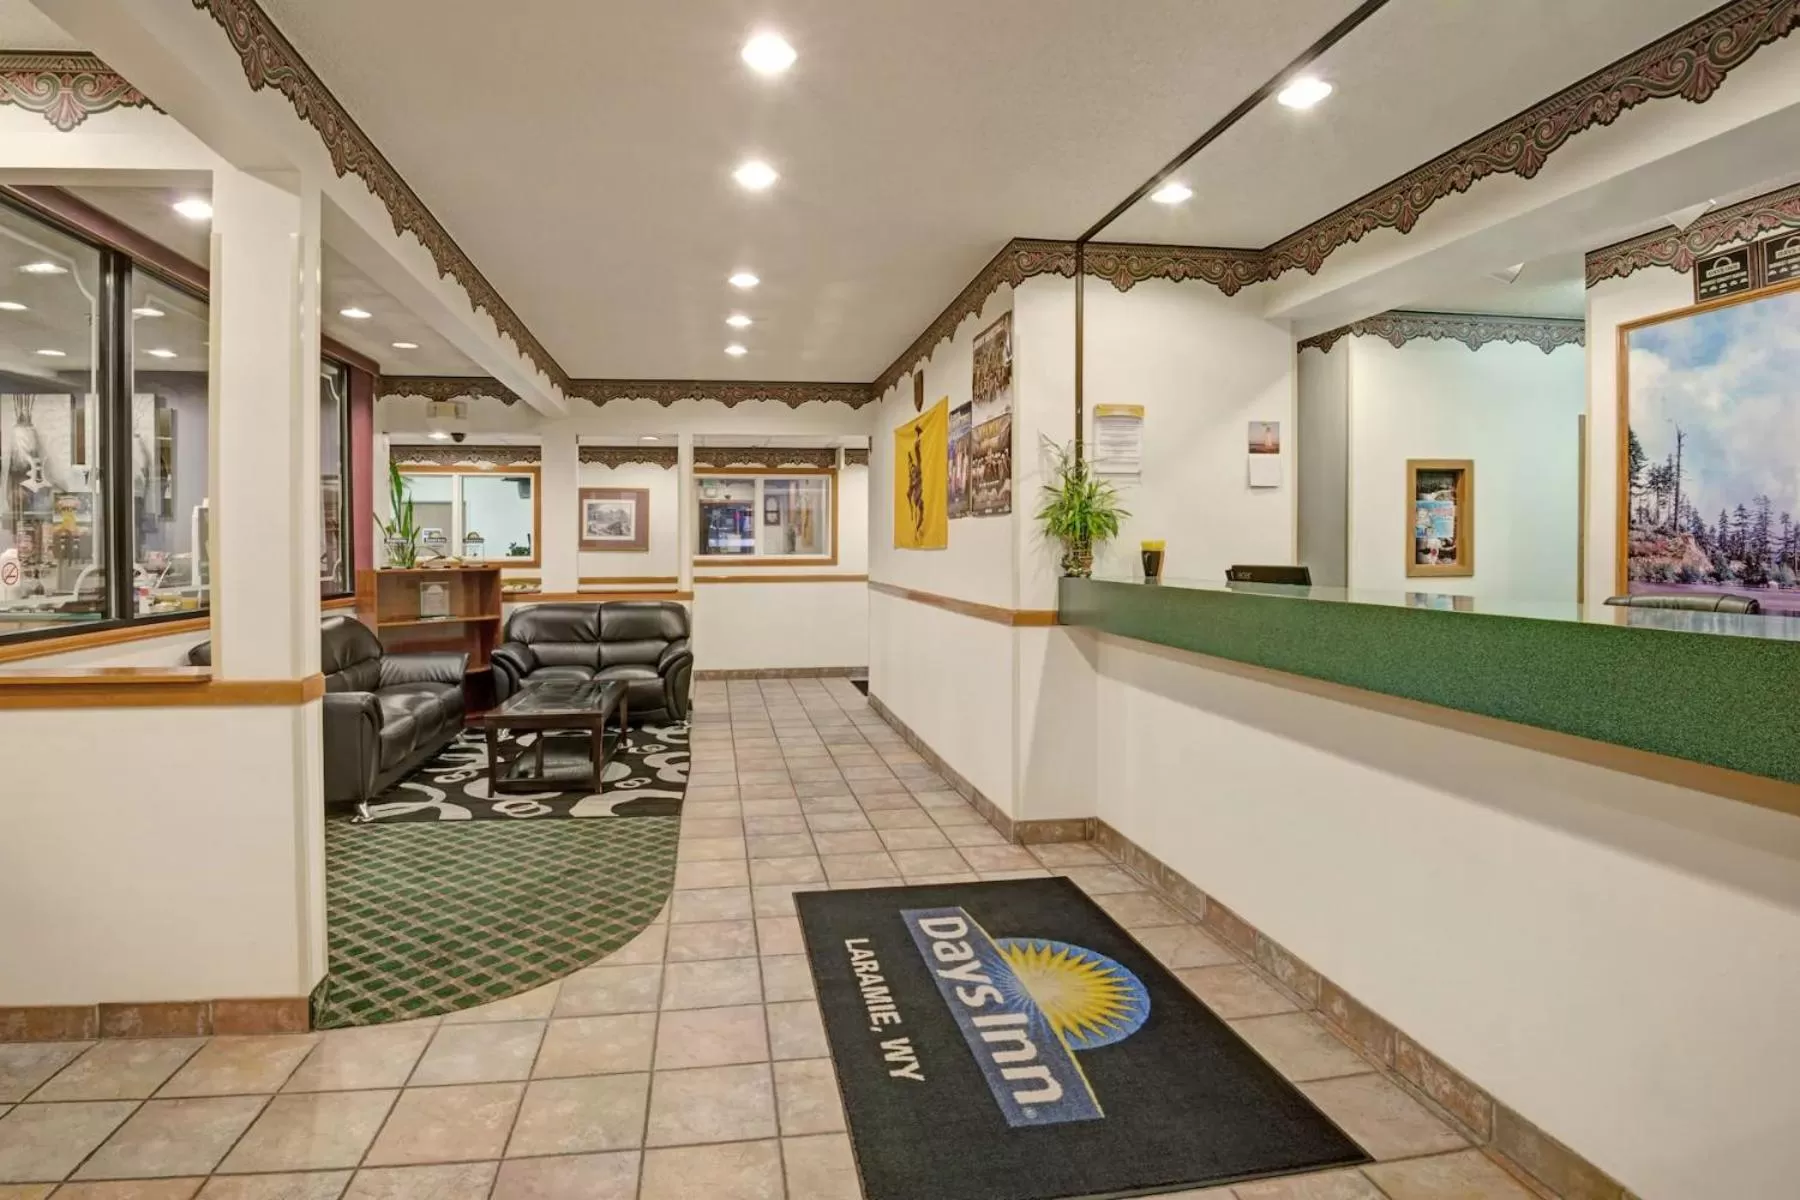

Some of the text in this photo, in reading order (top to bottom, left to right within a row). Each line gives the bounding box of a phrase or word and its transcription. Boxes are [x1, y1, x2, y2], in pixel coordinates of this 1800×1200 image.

[845, 938, 925, 1081] LARAMIE, WY
[918, 916, 1063, 1105] Days Inn
